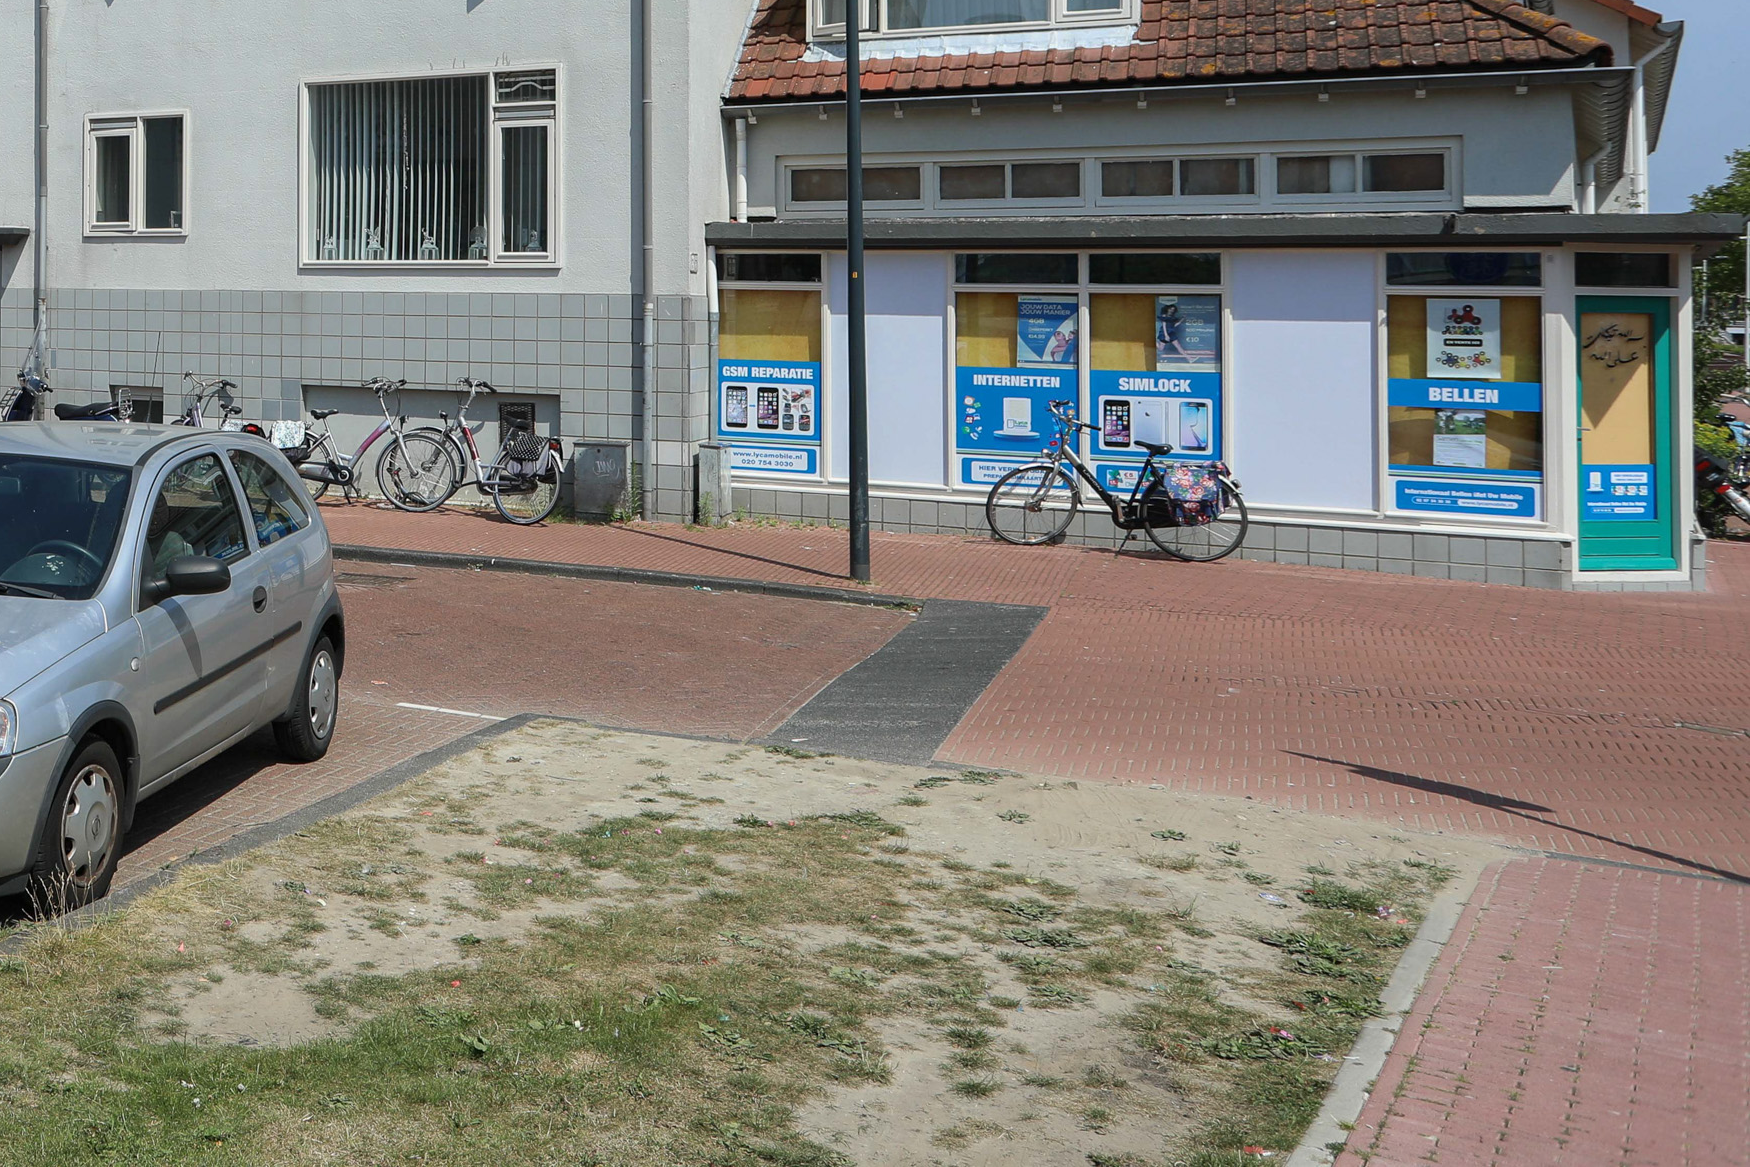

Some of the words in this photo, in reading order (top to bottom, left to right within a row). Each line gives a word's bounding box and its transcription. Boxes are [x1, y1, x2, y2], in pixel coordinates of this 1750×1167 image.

[722, 366, 748, 377] GSM
[751, 367, 814, 380] REPARATIE
[973, 374, 1061, 388] INTERNETTEN
[1118, 377, 1192, 393] SIMLOCK
[1428, 387, 1499, 404] BELLEN
[732, 450, 803, 461] www.lycamobile.nl
